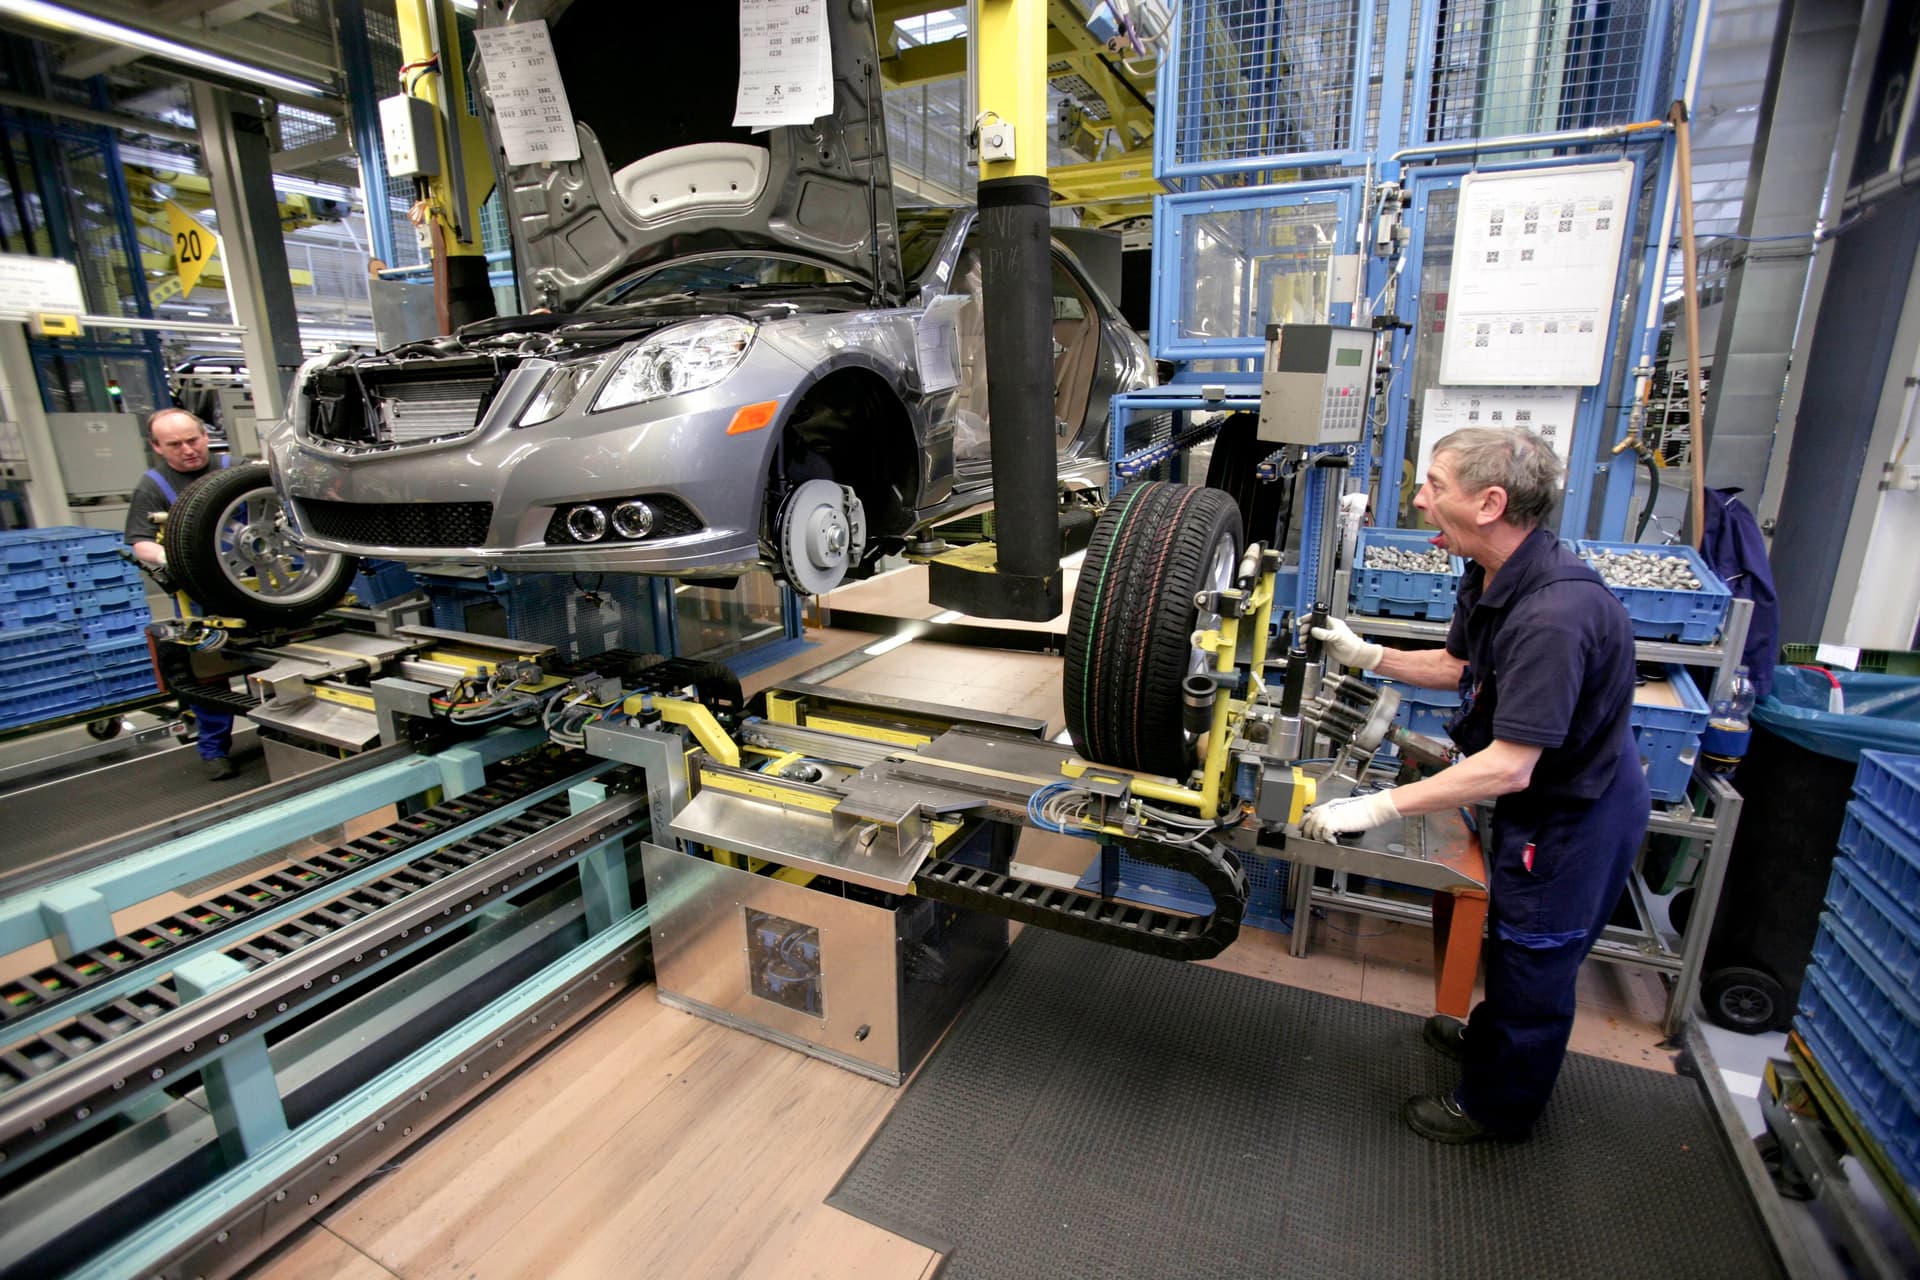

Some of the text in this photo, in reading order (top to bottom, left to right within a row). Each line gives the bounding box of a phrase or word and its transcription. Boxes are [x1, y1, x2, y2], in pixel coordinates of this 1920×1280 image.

[795, 5, 809, 16] U42
[774, 86, 781, 95] K
[176, 229, 202, 263] 20
